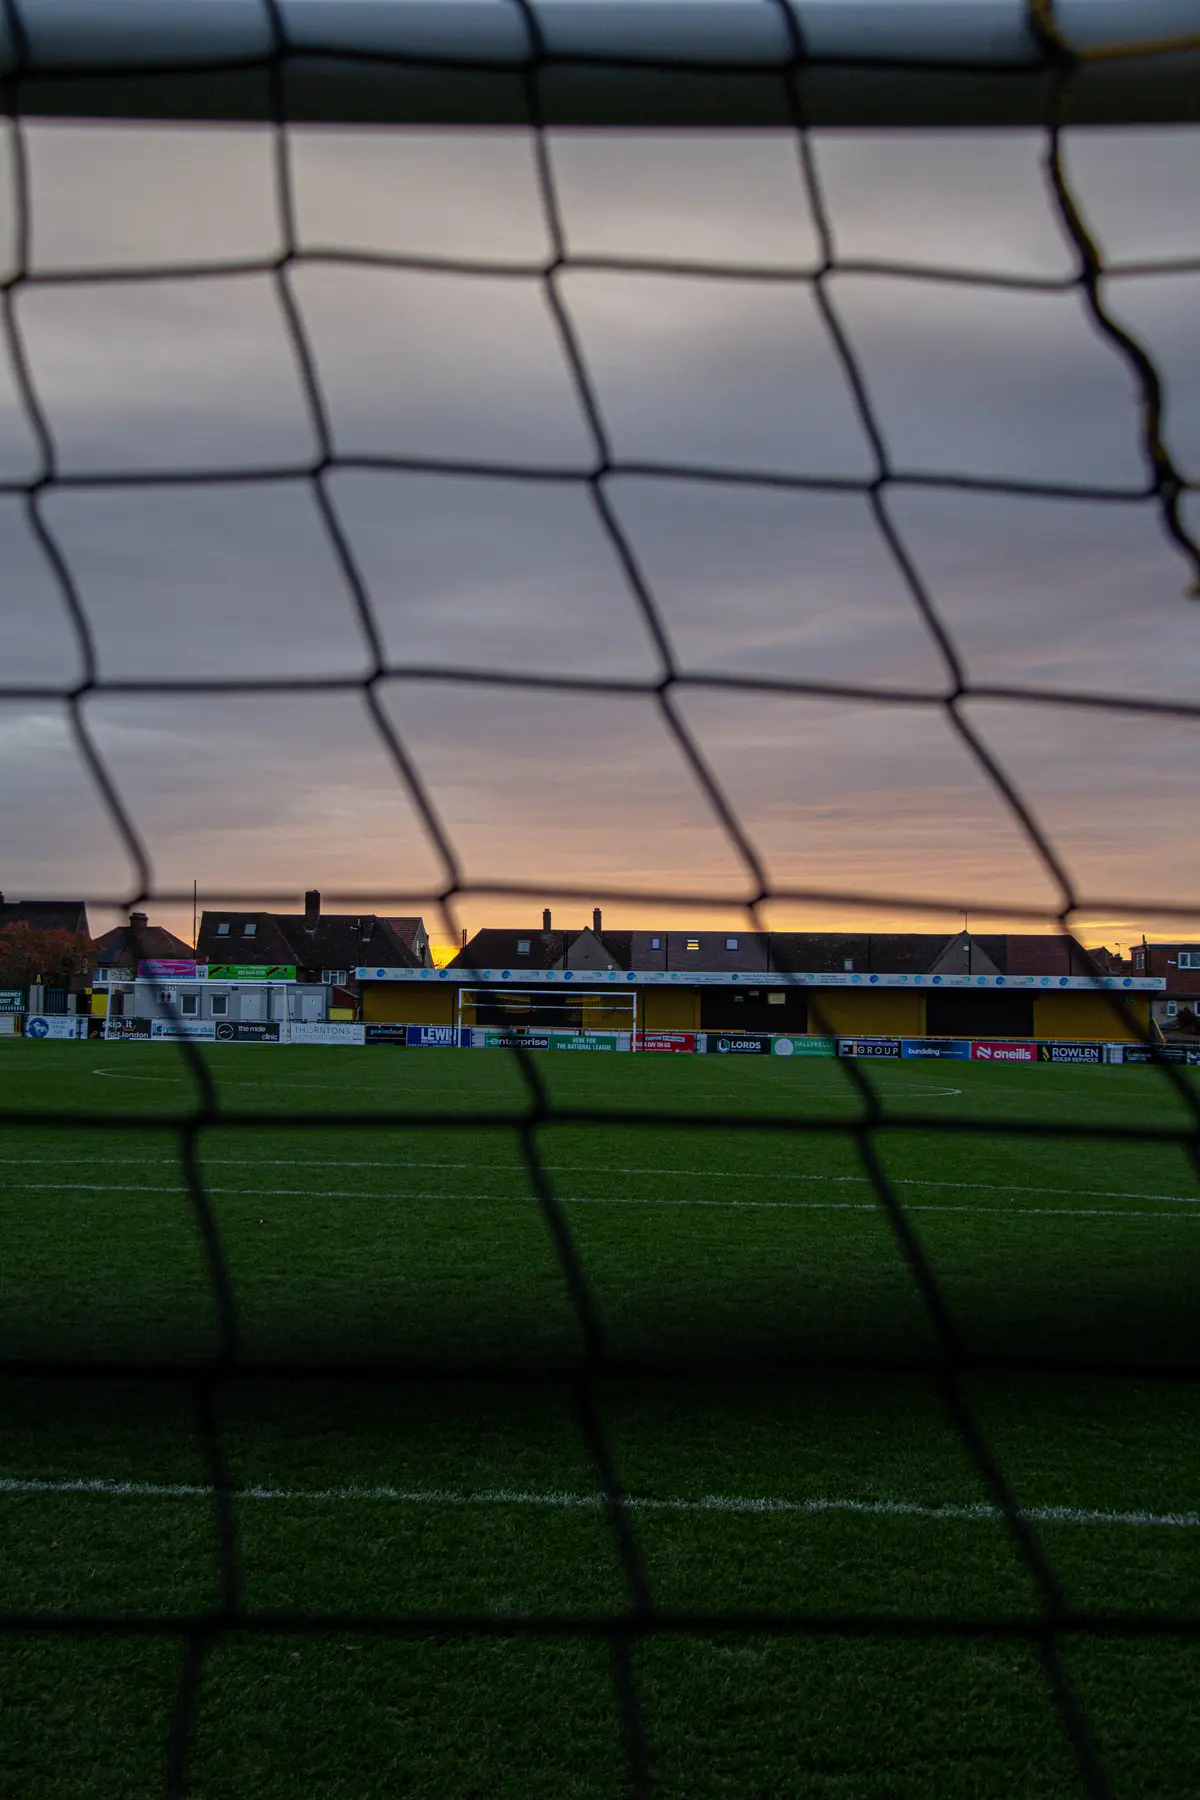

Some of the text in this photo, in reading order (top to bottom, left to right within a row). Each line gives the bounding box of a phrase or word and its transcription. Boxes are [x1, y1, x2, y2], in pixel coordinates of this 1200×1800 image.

[102, 1020, 132, 1029] skip it
[295, 1027, 350, 1035] THORNTONS
[858, 1046, 898, 1054] GROUP
[994, 1049, 1031, 1059] oneills
[1052, 1048, 1098, 1057] ROWLEN
